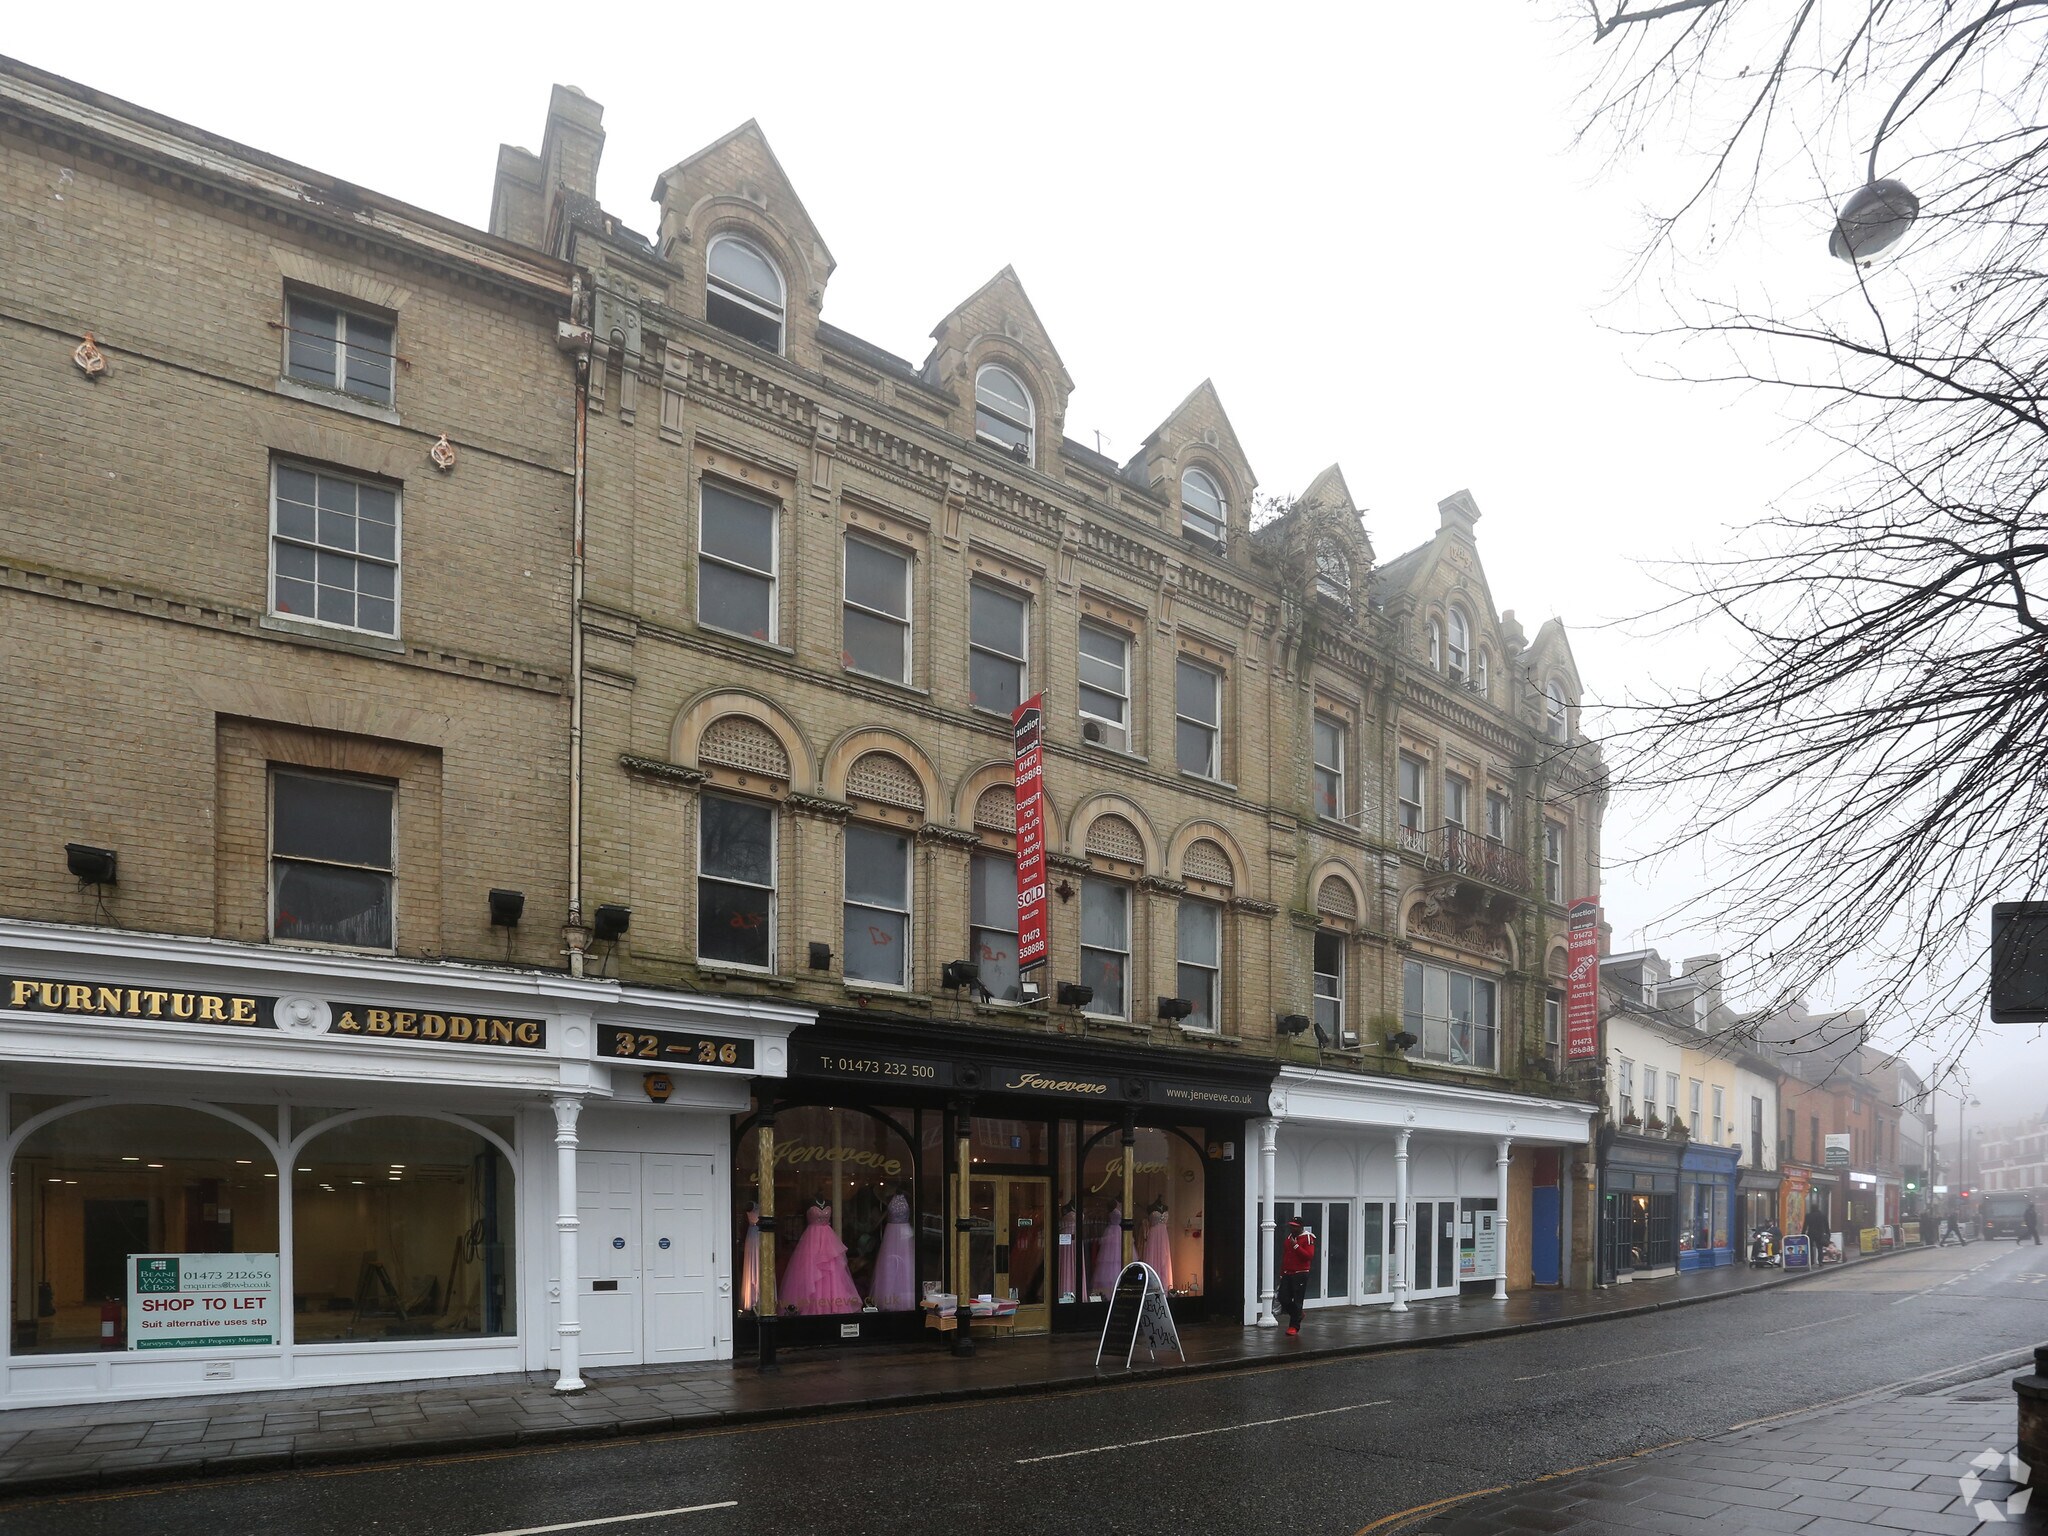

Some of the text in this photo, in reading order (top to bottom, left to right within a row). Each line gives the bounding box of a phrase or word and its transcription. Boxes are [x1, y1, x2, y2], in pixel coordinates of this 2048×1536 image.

[1023, 808, 1035, 819] FOR
[1023, 832, 1035, 844] AND
[1017, 886, 1044, 909] SOLD
[1570, 908, 1596, 919] auction
[1022, 928, 1041, 944] 01473
[1573, 930, 1593, 940] 01473
[1570, 955, 1595, 981] SOLD
[1571, 990, 1595, 1000] AUCTION
[9, 980, 540, 1044] FURNITURE & BEDDING
[838, 1058, 880, 1074] 01473
[884, 1062, 908, 1076] 232
[912, 1065, 935, 1078] 500
[1005, 1073, 1107, 1094] Jeneveve
[1166, 1089, 1253, 1104] www.jeneveve.co.uk
[183, 1271, 272, 1280] 01473 212656
[142, 1297, 267, 1312] SHOP TO LET
[141, 1320, 163, 1329] Suit
[166, 1318, 221, 1328] alternative
[251, 1317, 268, 1327] stp
[237, 1336, 270, 1344] Managers
